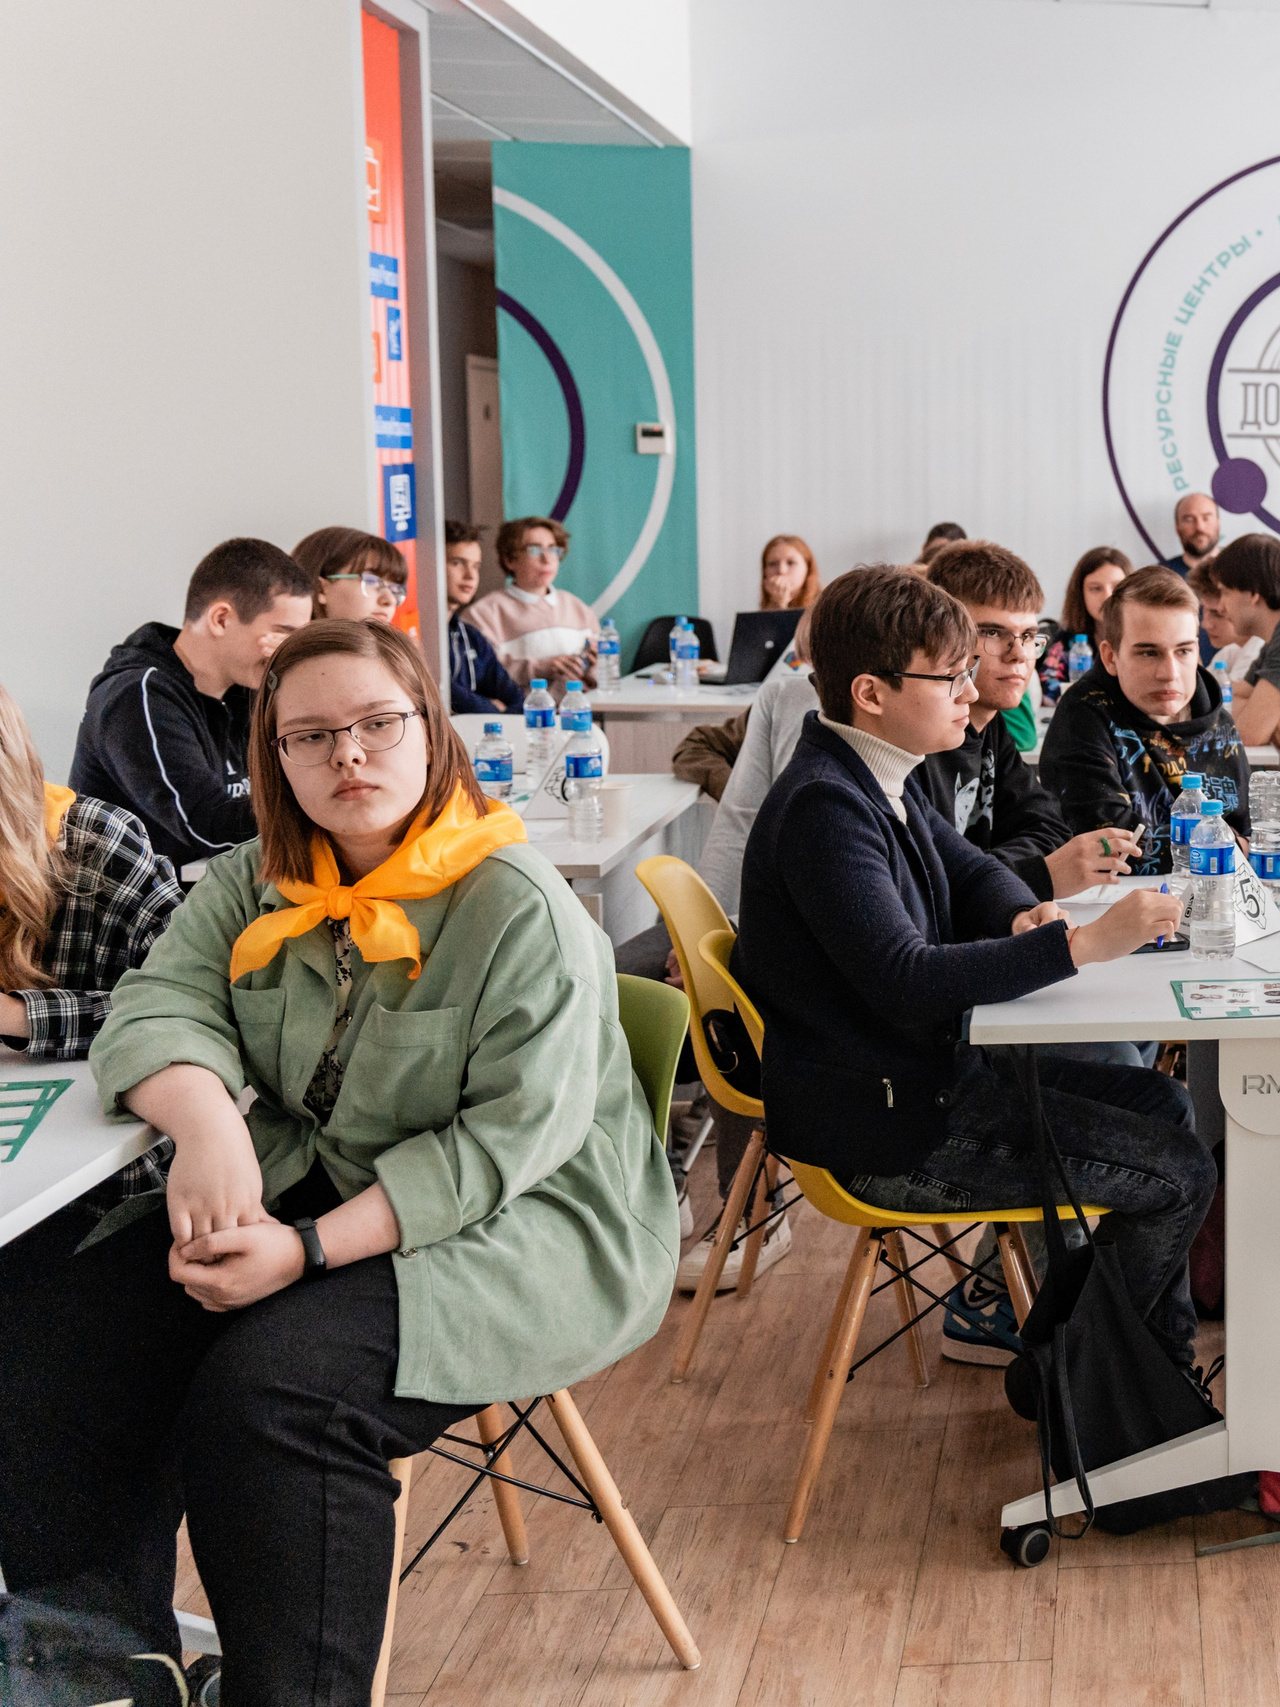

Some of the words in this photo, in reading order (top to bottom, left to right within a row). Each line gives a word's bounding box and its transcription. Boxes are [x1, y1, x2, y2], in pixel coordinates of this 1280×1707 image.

[1156, 330, 1190, 492] РЕСУРСНЫЕ
[1174, 235, 1253, 326] ЦЕНТРЫ
[1239, 878, 1260, 918] 5
